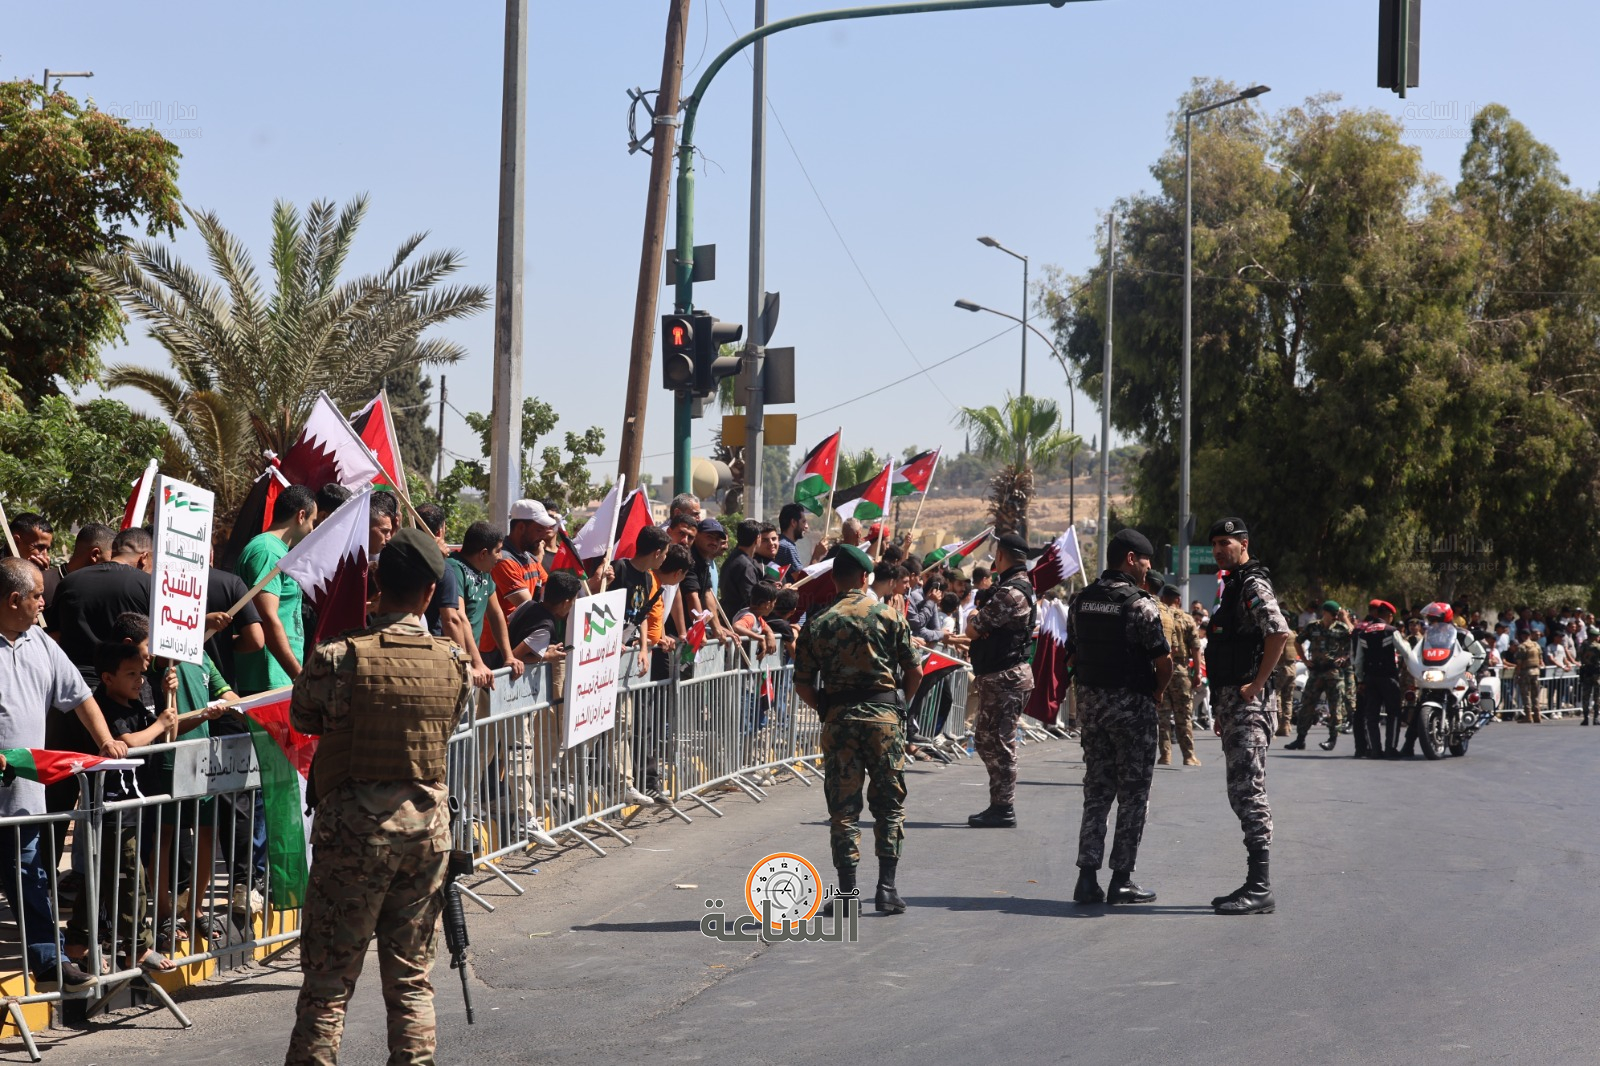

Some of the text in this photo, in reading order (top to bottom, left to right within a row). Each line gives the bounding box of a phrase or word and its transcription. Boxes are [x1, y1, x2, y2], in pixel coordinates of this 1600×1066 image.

[162, 566, 202, 605] بالشيخ
[161, 604, 199, 631] تميم
[1081, 601, 1121, 614] GENDARMERIE
[160, 636, 174, 650] الخير
[188, 643, 198, 660] في
[576, 667, 614, 701] بالشيخ تميم
[574, 705, 590, 732] الخير
[601, 698, 611, 725] في
[201, 756, 235, 783] المدينة
